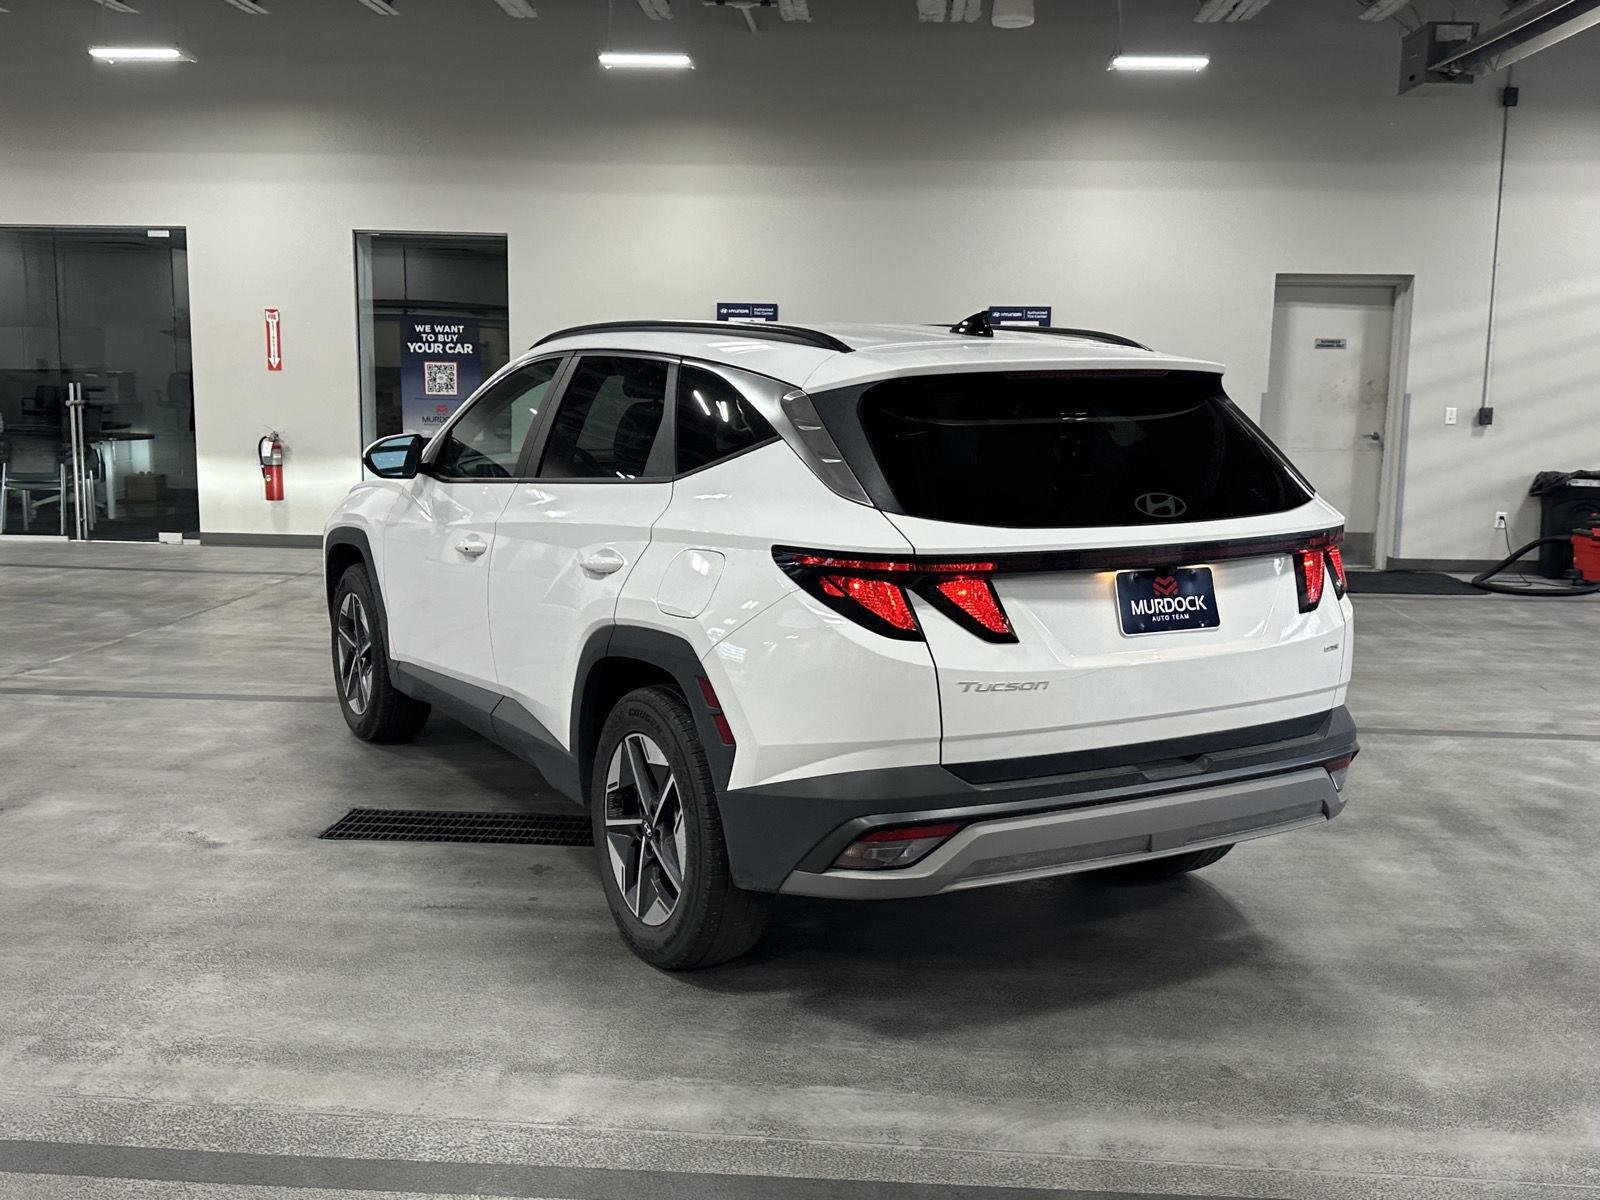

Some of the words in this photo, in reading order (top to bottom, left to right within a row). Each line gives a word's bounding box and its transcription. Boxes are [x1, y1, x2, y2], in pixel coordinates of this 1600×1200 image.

[414, 324, 432, 333] WE
[433, 325, 465, 333] WANT
[421, 333, 435, 342] TO
[437, 334, 459, 342] BUY
[407, 342, 443, 353] YOUR
[445, 343, 473, 354] CAR
[421, 415, 451, 424] MURD
[1130, 595, 1207, 615] MURDOCK
[1151, 614, 1170, 622] AUTO
